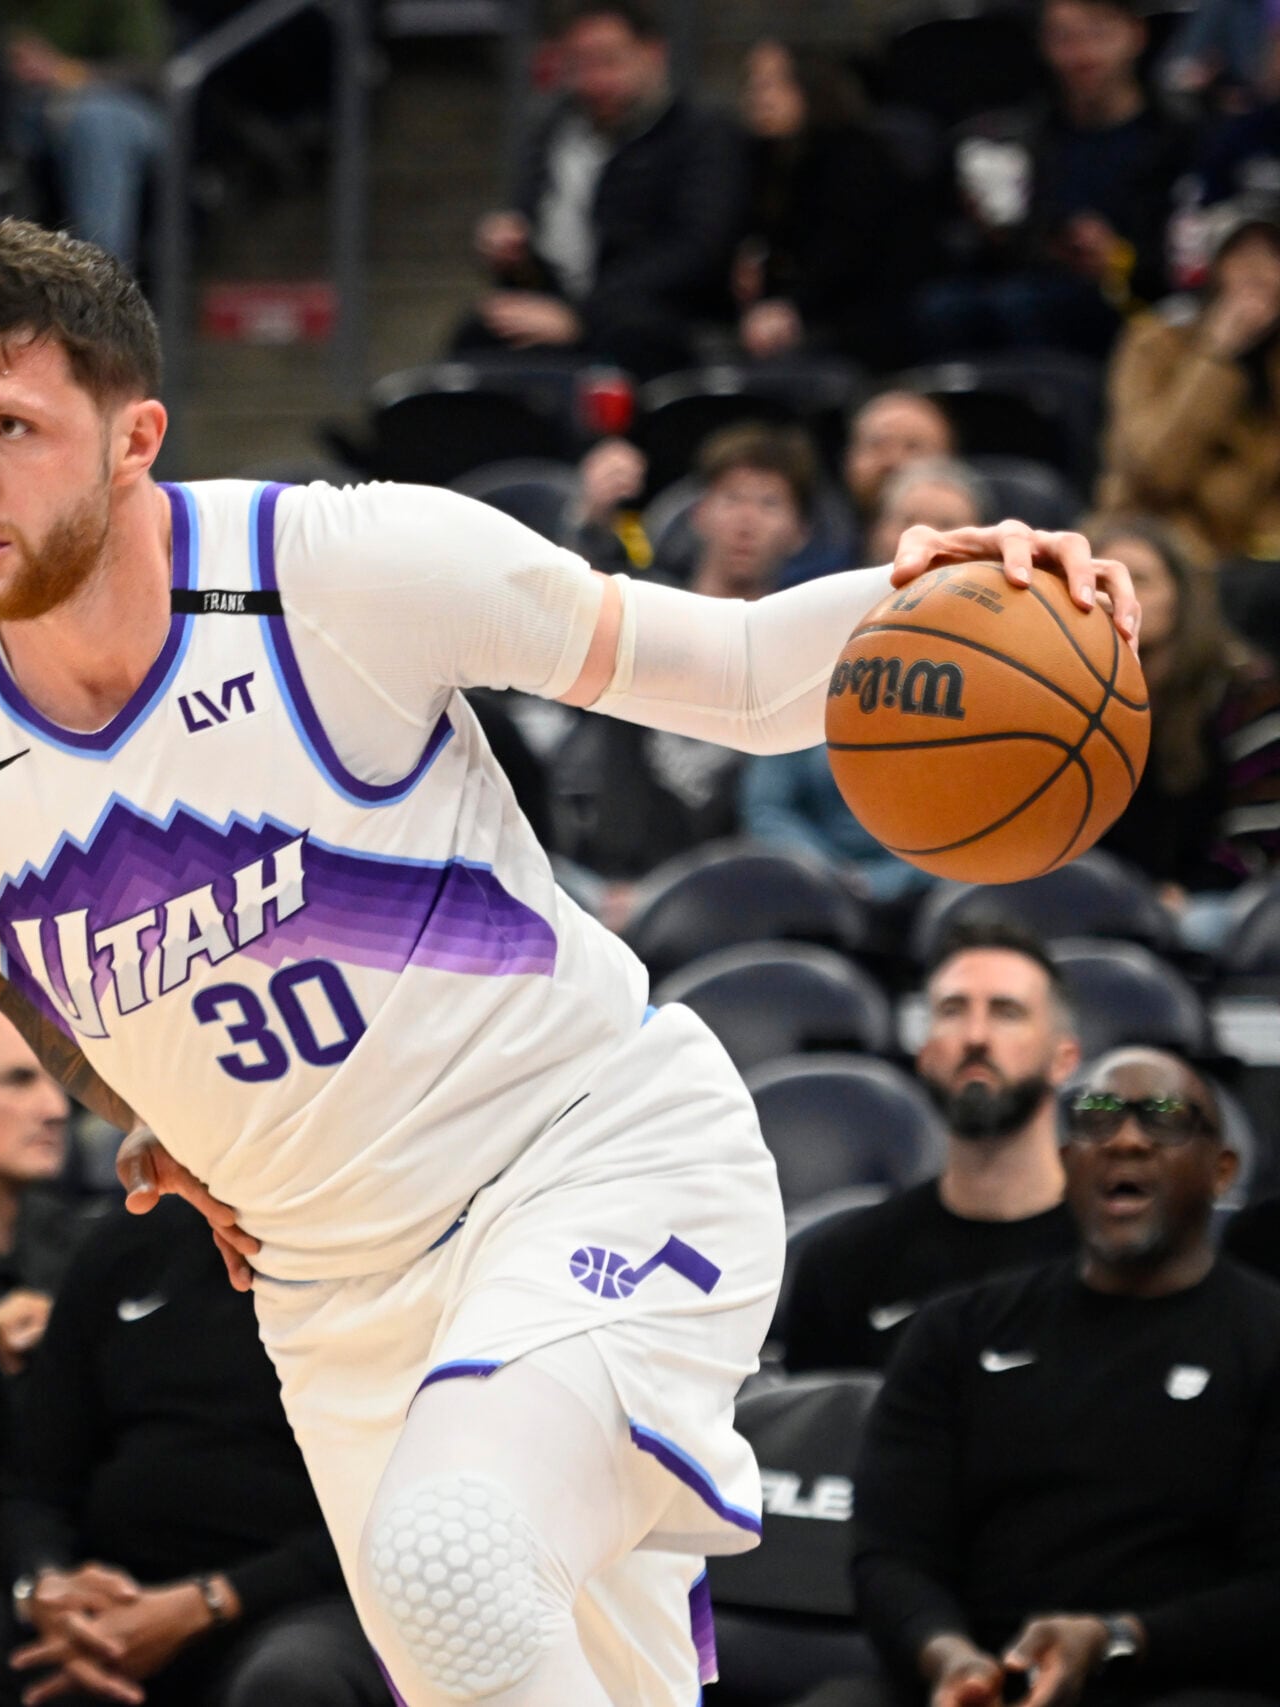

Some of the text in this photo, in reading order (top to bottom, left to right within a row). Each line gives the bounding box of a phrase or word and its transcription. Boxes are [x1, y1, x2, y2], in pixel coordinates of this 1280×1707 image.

[203, 592, 246, 611] FRANK
[178, 670, 256, 734] LVT
[827, 656, 966, 721] Wilso
[10, 829, 310, 1039] UTAH
[191, 957, 368, 1084] 30
